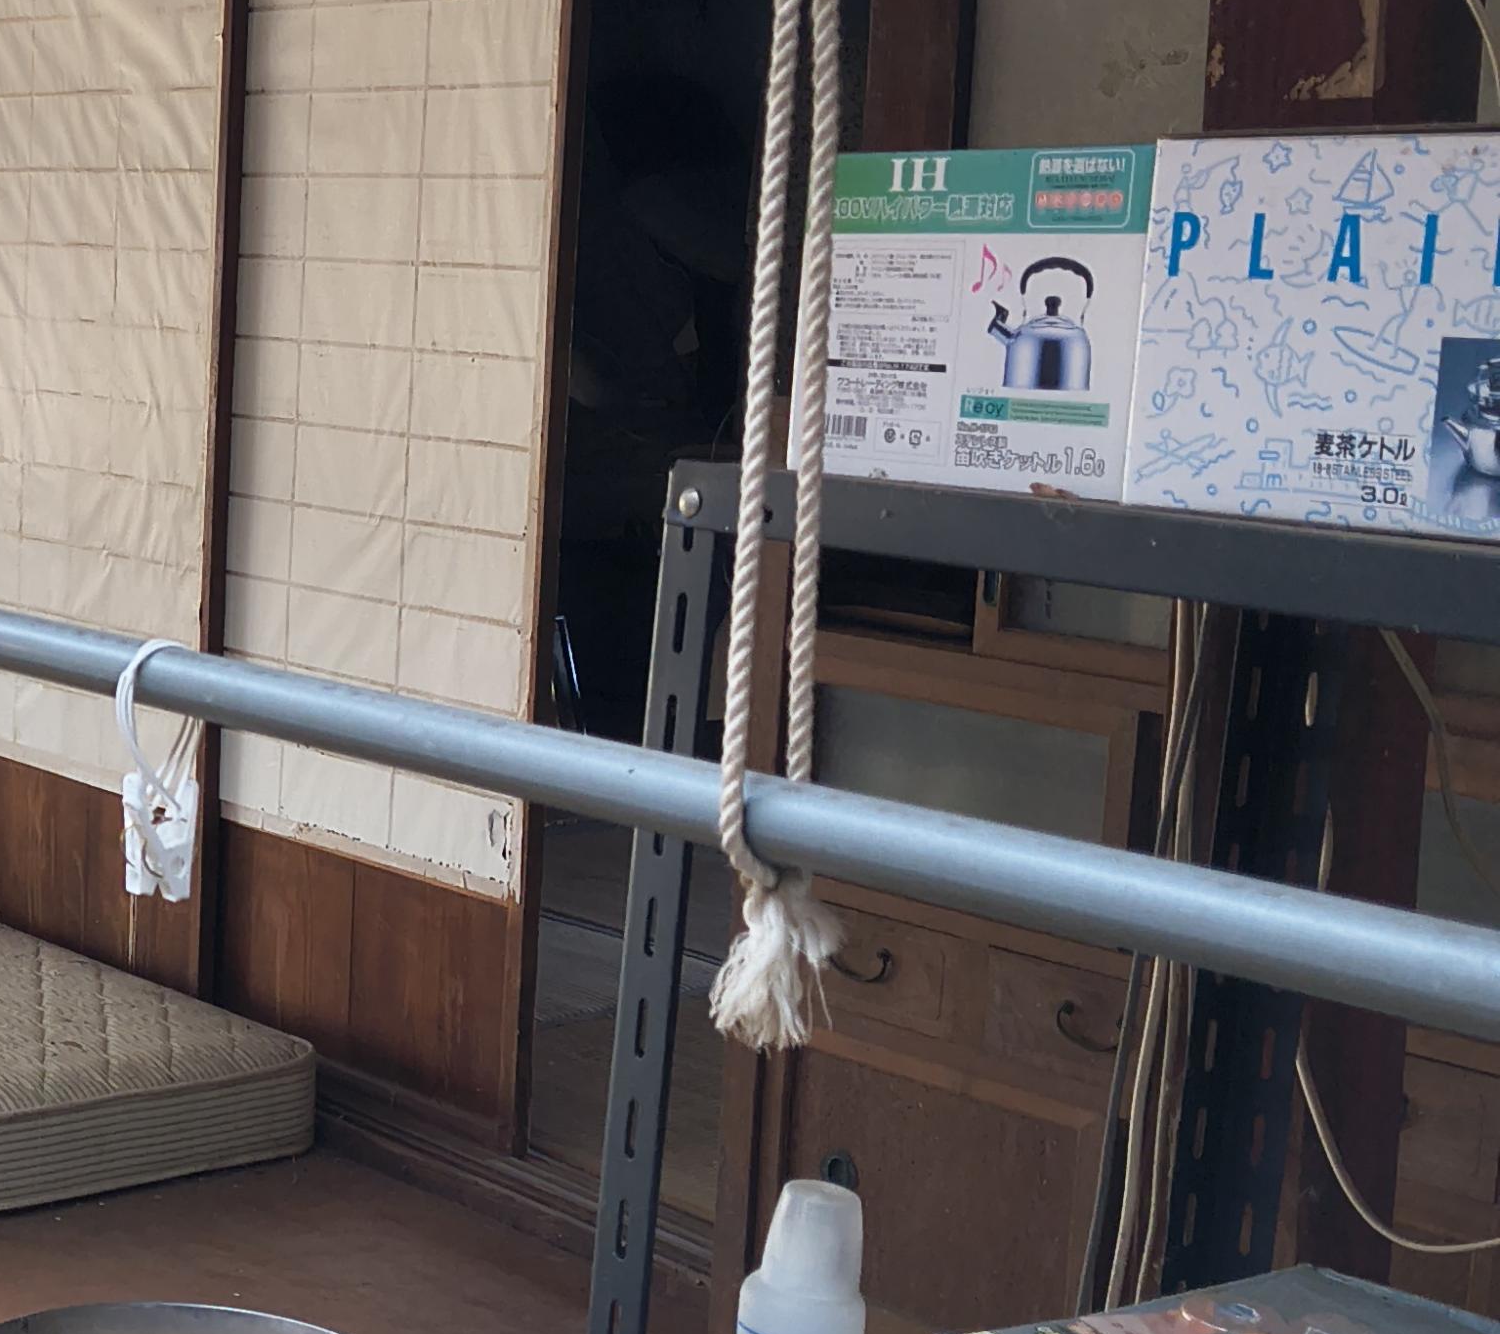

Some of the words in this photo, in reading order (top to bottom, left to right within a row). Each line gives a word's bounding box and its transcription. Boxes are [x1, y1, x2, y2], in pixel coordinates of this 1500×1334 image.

[888, 156, 950, 192] IH
[1168, 211, 1500, 287] PLAI
[1314, 432, 1416, 462] 麦茶ケトル
